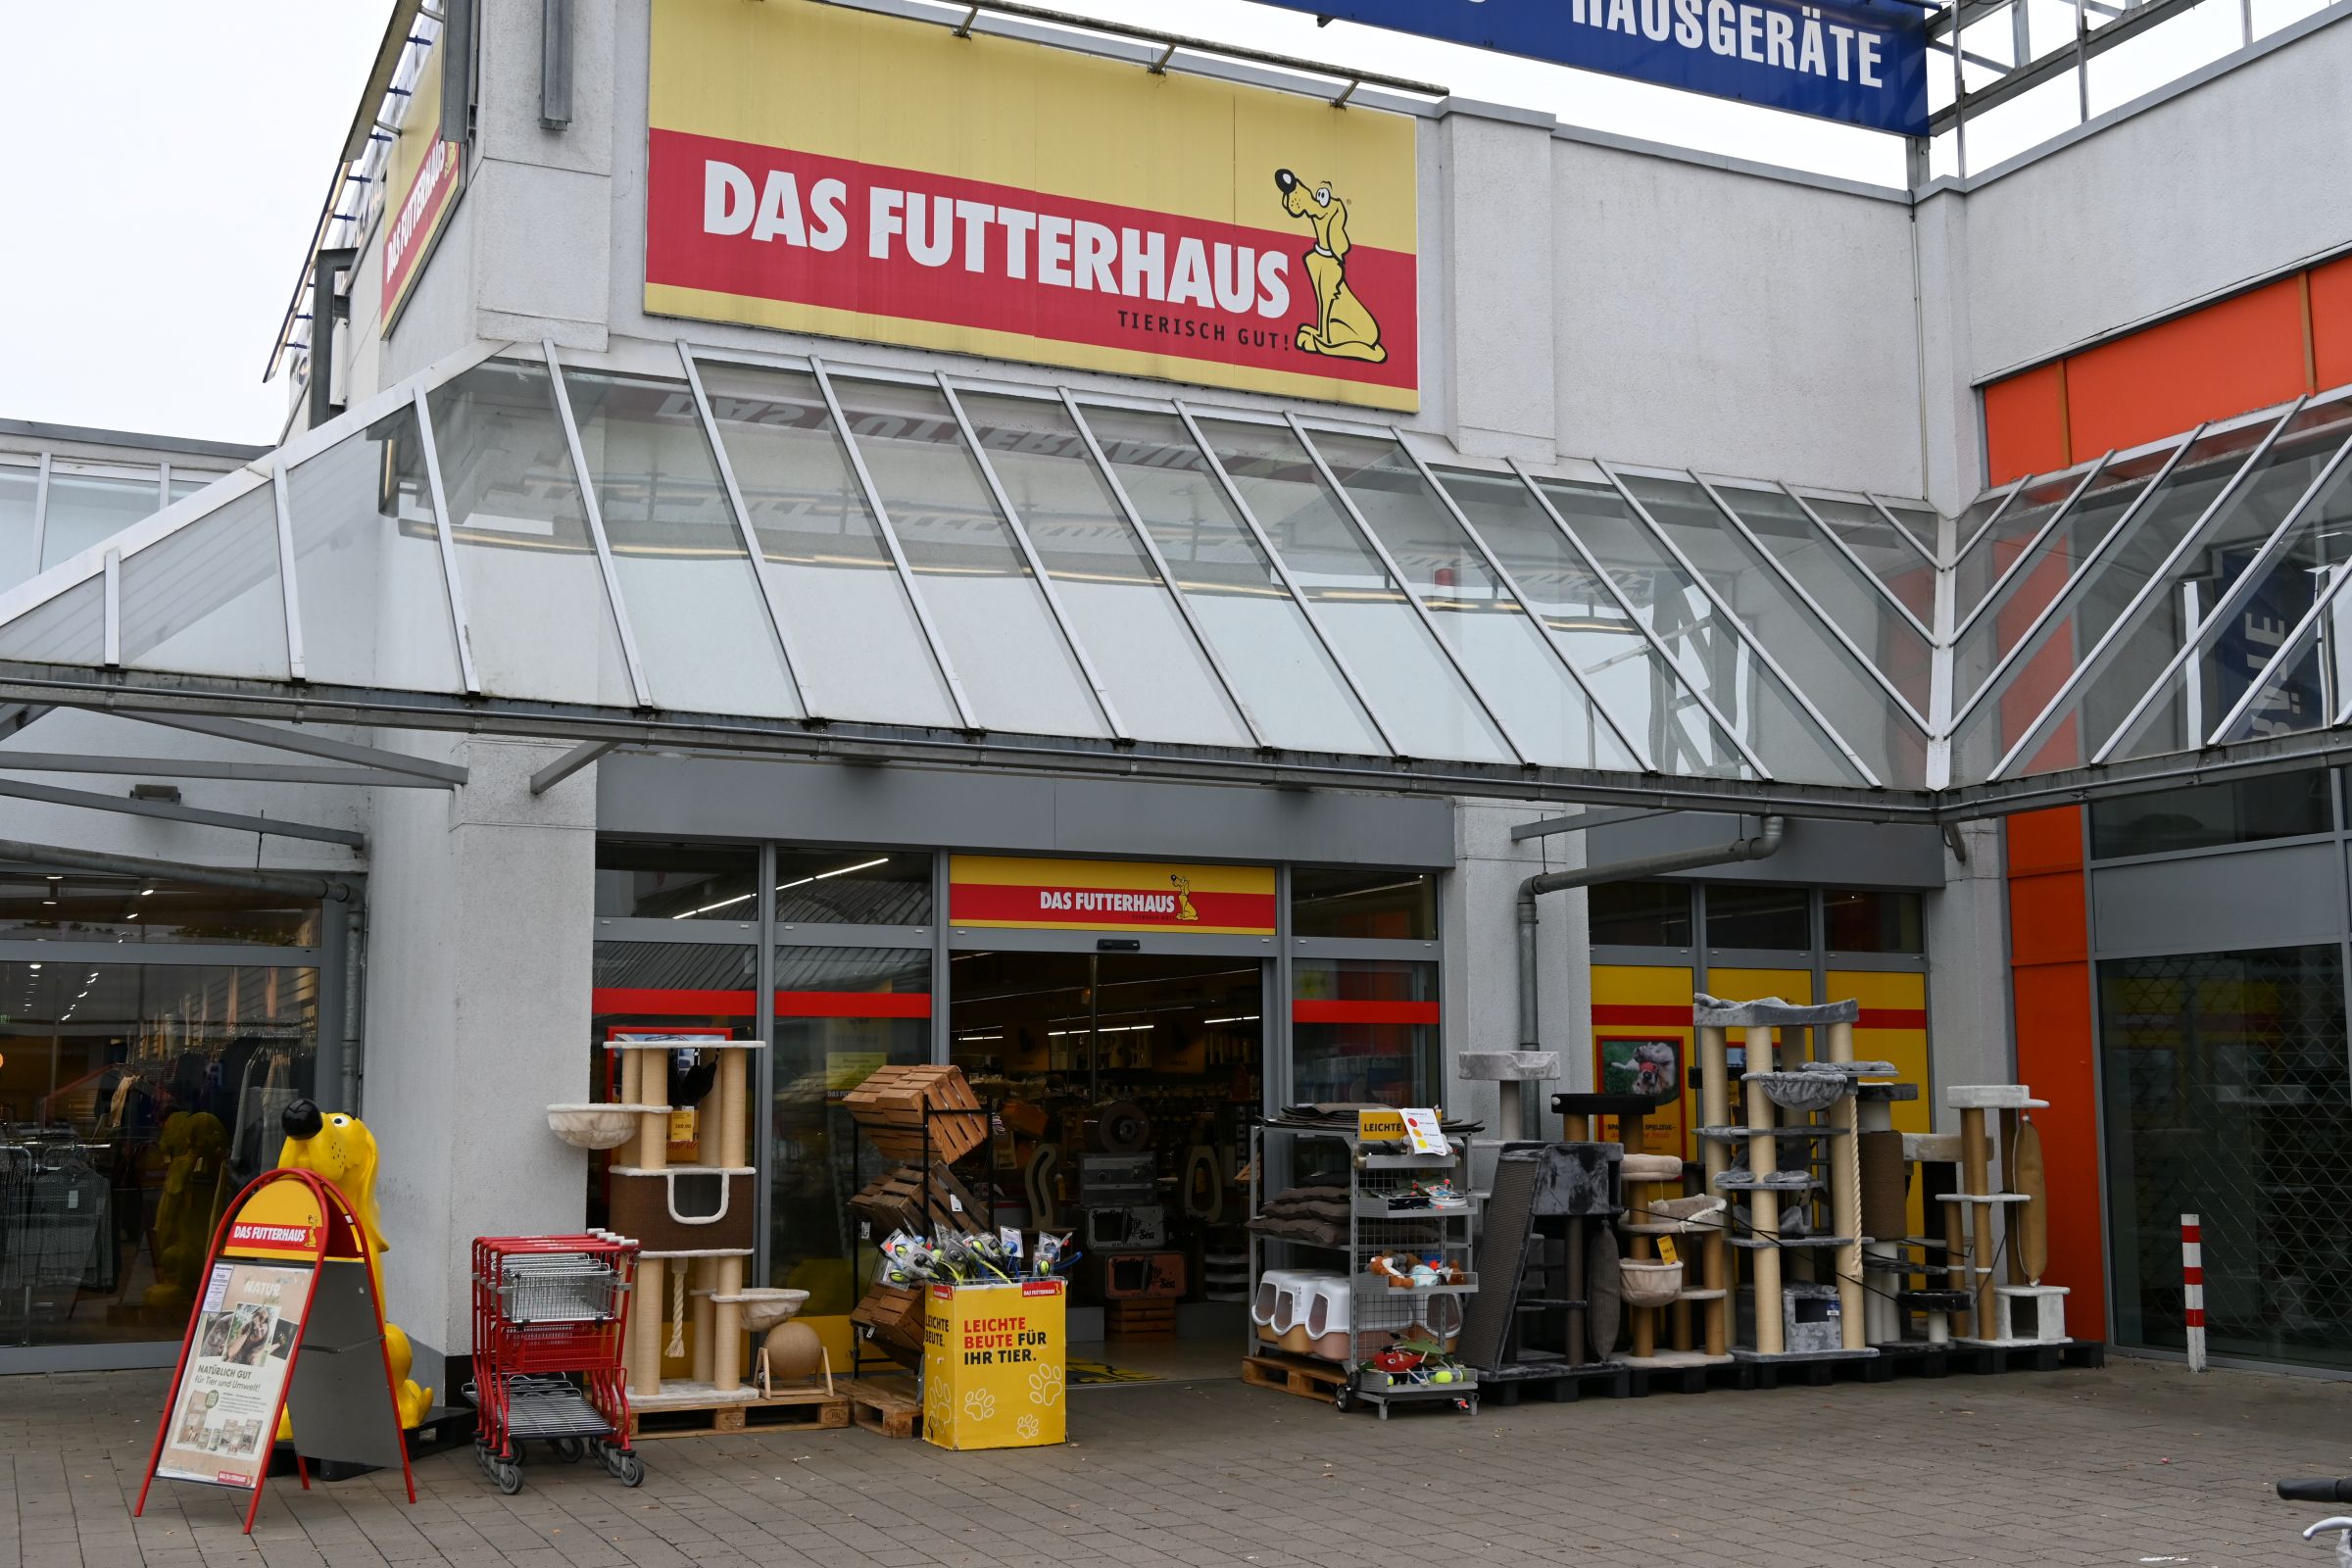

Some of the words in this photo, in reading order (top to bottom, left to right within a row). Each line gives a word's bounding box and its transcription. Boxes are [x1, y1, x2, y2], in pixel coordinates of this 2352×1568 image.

[387, 221, 402, 283] DAS
[401, 138, 446, 256] FUTTERHAUS
[704, 160, 848, 252] DAS
[868, 187, 1291, 318] FUTTERHAUS
[1118, 311, 1225, 341] TIERISCH
[1238, 328, 1290, 351] GUT!
[1040, 891, 1072, 910] DAS
[1075, 892, 1175, 913] FUTTERHAUS
[1363, 1123, 1401, 1132] LEICHTE
[233, 1225, 253, 1239] DAS
[252, 1227, 307, 1242] FUTTERHAUS
[243, 1280, 281, 1297] NATUR
[925, 1314, 950, 1332] LEICHTE
[963, 1316, 1026, 1334] LEICHTE
[925, 1330, 946, 1348] BEUTE.
[963, 1334, 1013, 1348] BEUTE
[1017, 1329, 1047, 1347] FÜR
[963, 1350, 993, 1365] IHR
[998, 1348, 1037, 1363] TIER.
[197, 1364, 236, 1378] NATÜRLICH
[236, 1370, 252, 1380] GUT
[195, 1375, 205, 1384] für
[206, 1376, 218, 1386] Tier
[218, 1379, 231, 1388] und
[231, 1380, 261, 1392] Umwelt!
